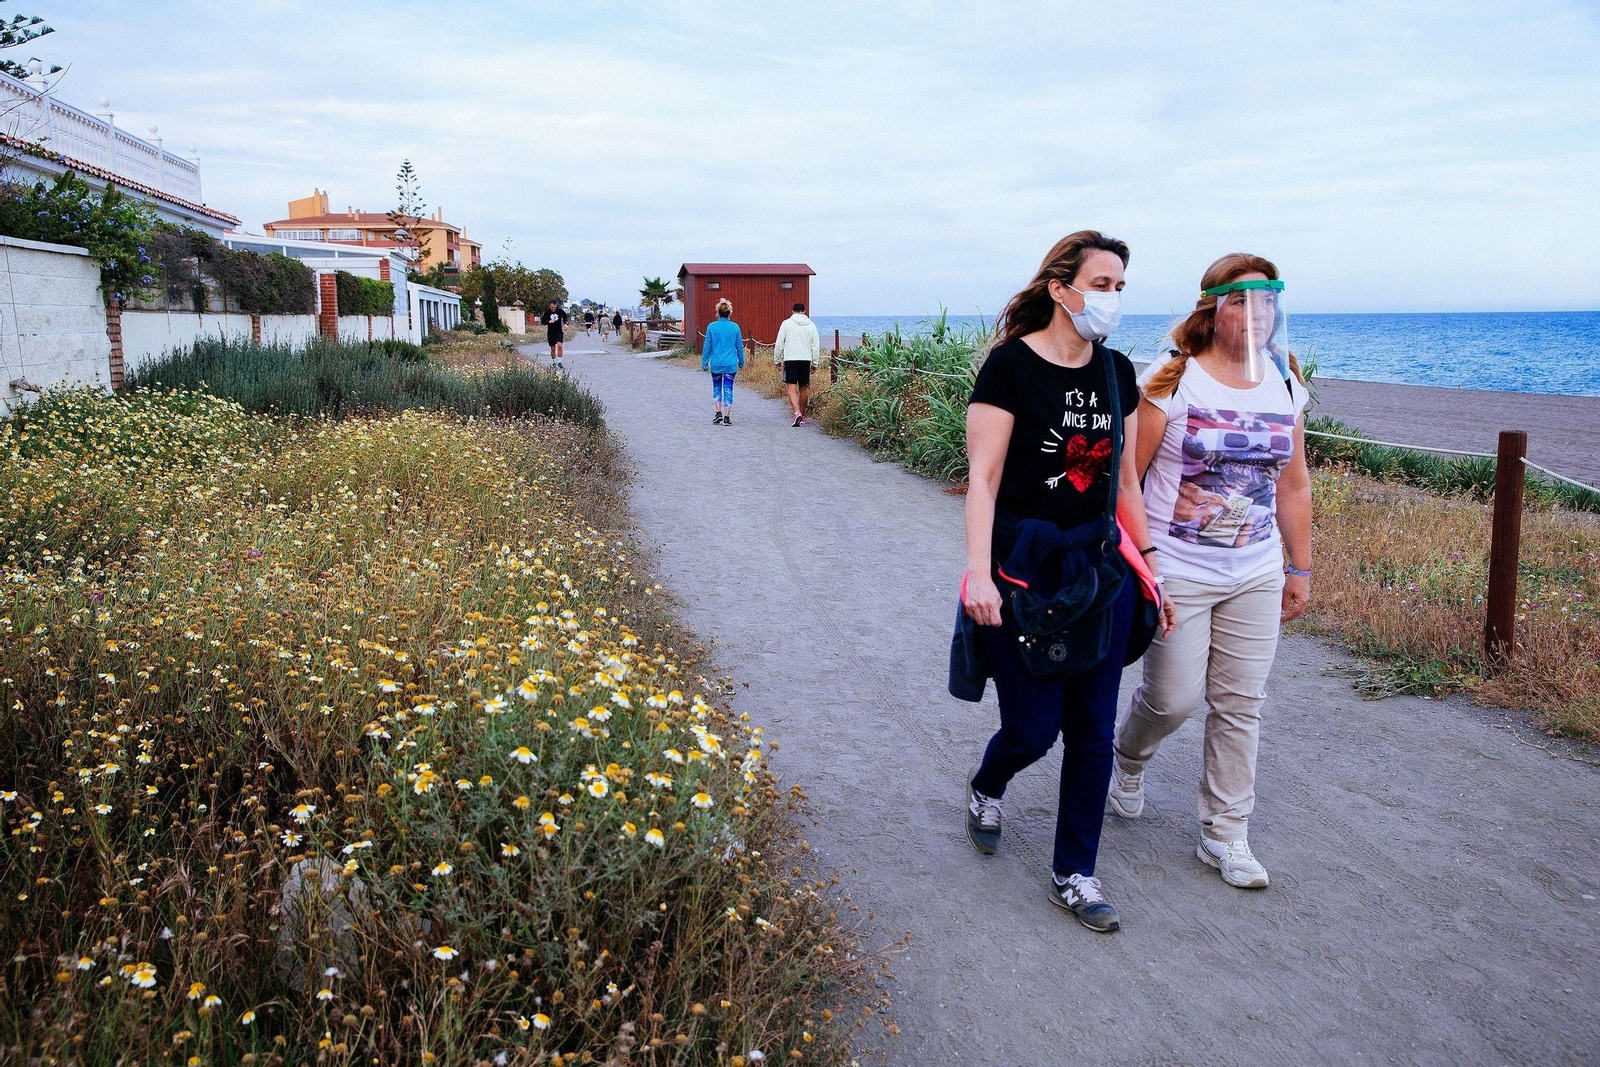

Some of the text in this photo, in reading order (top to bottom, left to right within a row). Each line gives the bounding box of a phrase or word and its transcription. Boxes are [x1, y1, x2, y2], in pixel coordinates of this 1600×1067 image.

[1065, 388, 1098, 408] IT'S A
[1062, 411, 1112, 430] NICE DAY
[1061, 888, 1079, 906] N
